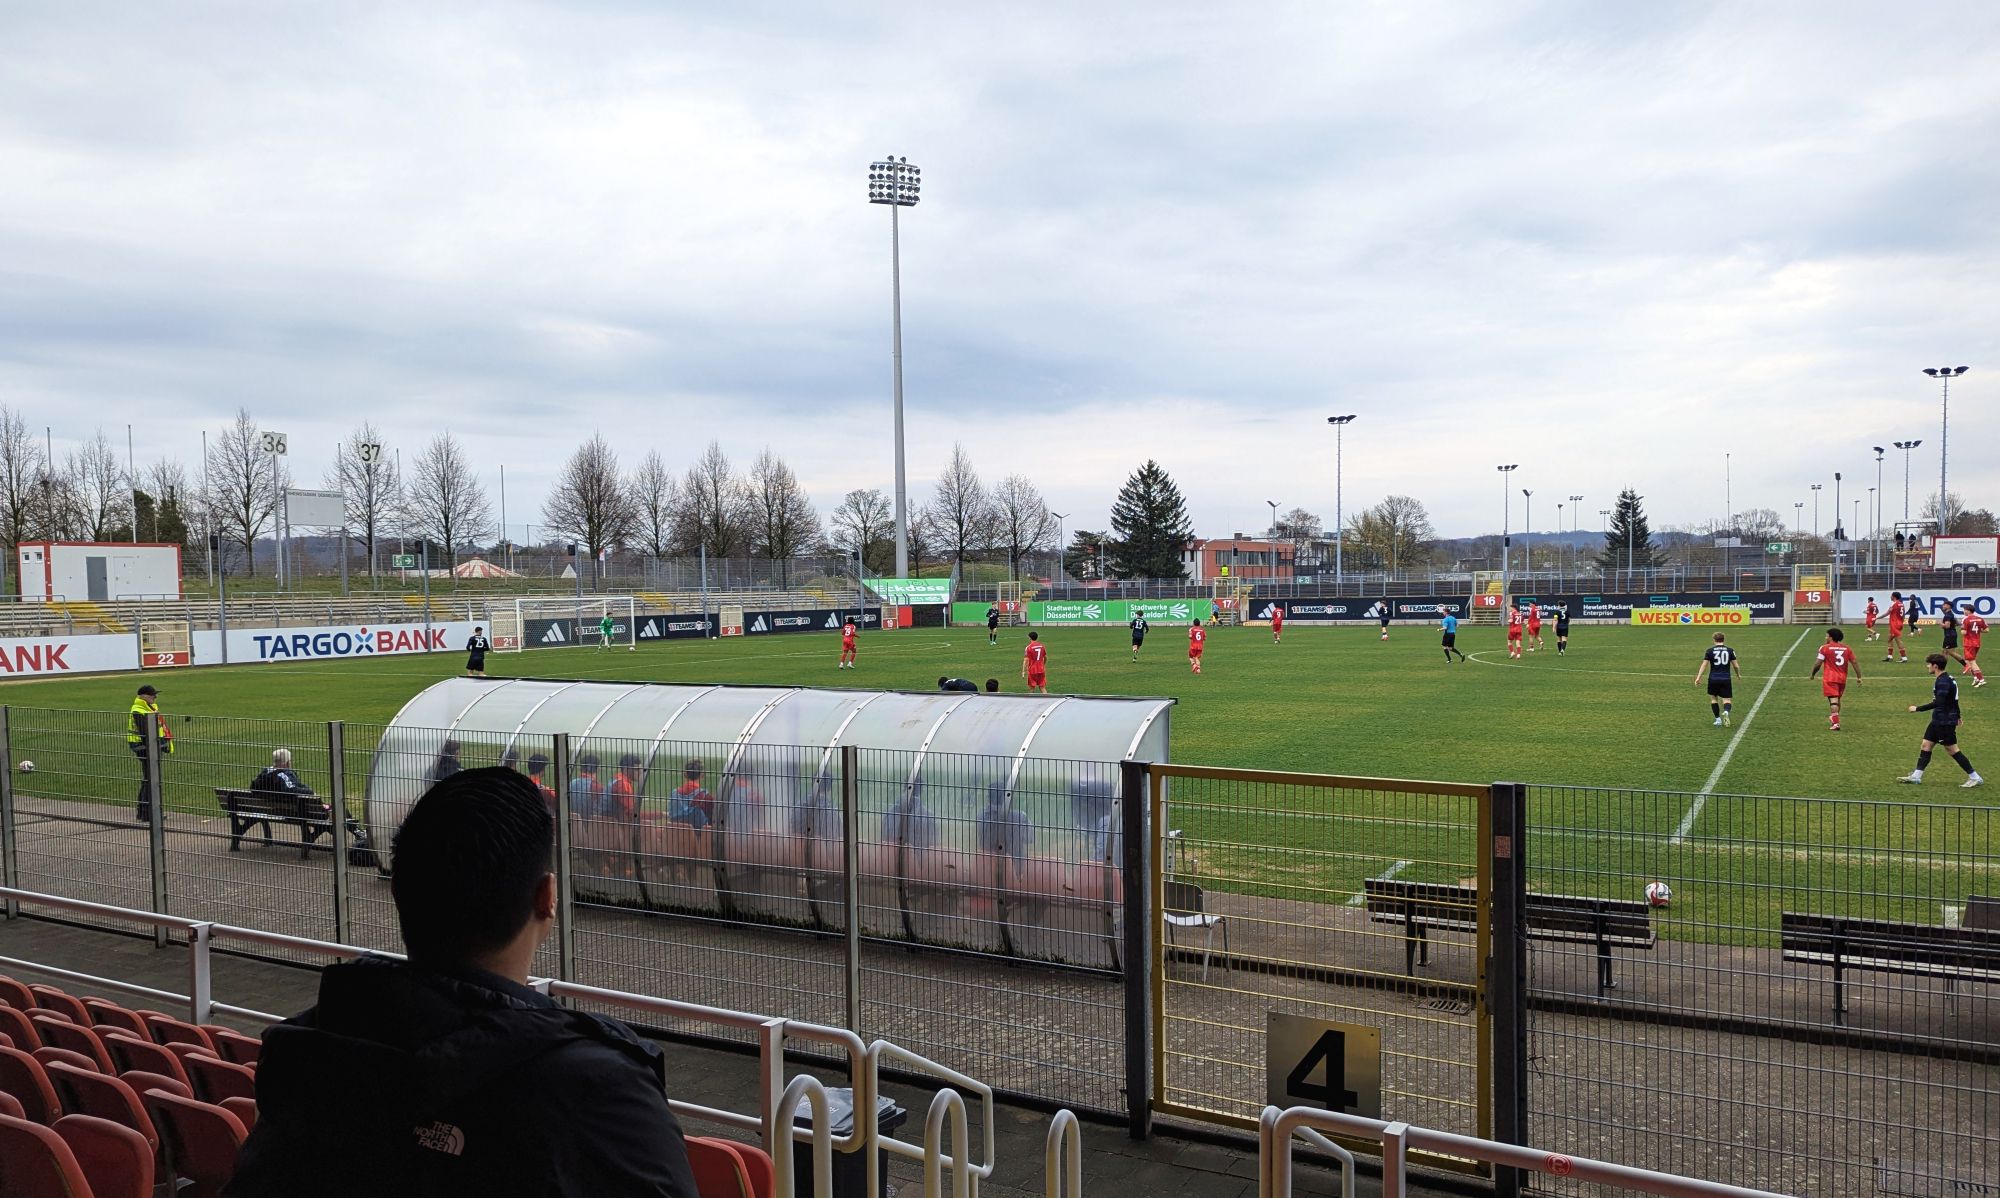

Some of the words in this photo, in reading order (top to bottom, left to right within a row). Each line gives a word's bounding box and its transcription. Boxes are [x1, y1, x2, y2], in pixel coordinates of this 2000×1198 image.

[263, 434, 286, 454] 36
[361, 443, 381, 462] 37
[1483, 596, 1495, 606] 16
[1805, 591, 1821, 603] 15
[1222, 600, 1231, 608] 17
[1046, 611, 1082, 619] Düsseldorf
[1514, 615, 1522, 624] 21
[1561, 610, 1566, 620] 5
[1639, 612, 1679, 624] WEST
[1693, 612, 1742, 624] LOTTO
[1135, 620, 1143, 629] 15
[1971, 621, 1979, 634] 4
[727, 627, 736, 635] 20
[1195, 631, 1201, 640] 6
[475, 638, 485, 648] 25
[503, 638, 513, 647] 21
[157, 654, 175, 665] 22
[1035, 648, 1041, 661] 7
[1713, 650, 1729, 666] 30
[1834, 650, 1845, 666] 3
[1286, 1029, 1358, 1113] 4
[433, 1121, 452, 1134] THE
[418, 1136, 444, 1151] FACE
